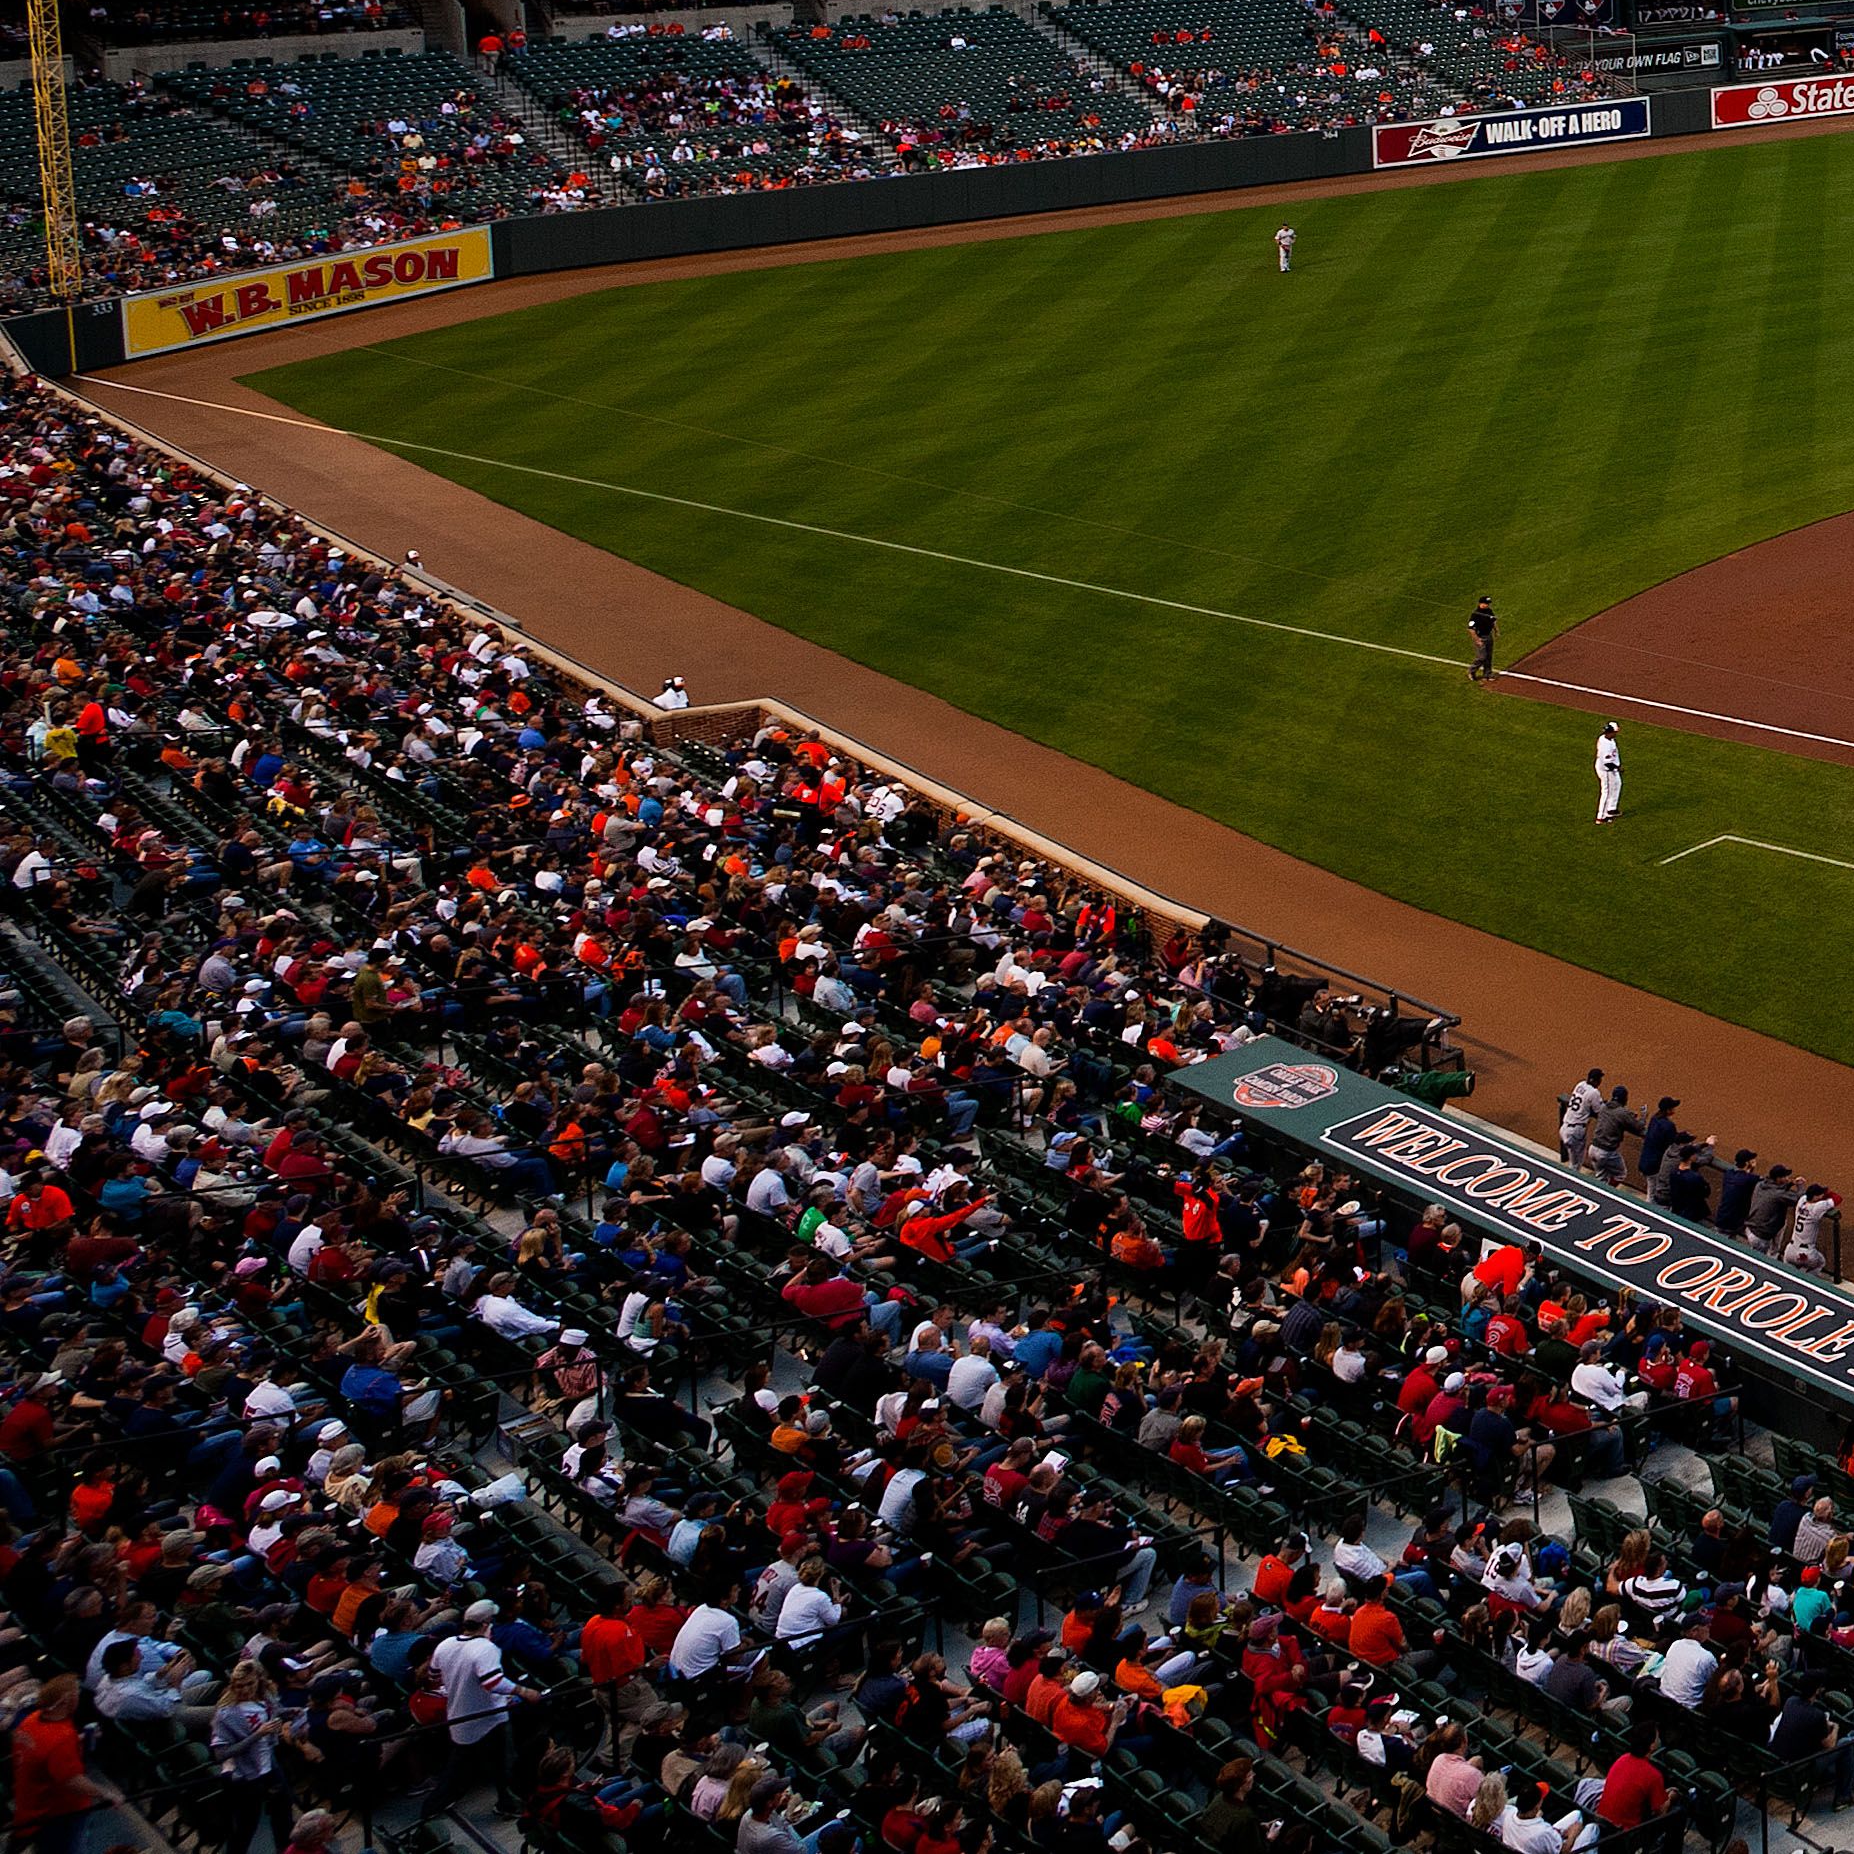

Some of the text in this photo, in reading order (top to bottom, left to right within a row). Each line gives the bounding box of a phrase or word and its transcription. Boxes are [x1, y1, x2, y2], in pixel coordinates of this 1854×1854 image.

[1596, 56, 1624, 72] YOUR
[1626, 55, 1653, 69] OWN
[1655, 51, 1682, 66] FLAG
[1568, 115, 1581, 134] A
[1581, 109, 1622, 133] HERO
[1322, 130, 1339, 140] 364
[1408, 130, 1477, 147] Budweiser
[178, 248, 460, 340] W.B. MASON
[288, 291, 366, 316] SINCE 1898
[91, 301, 115, 317] 333
[1351, 1110, 1600, 1234] WELCOME
[1573, 1213, 1674, 1267] TO
